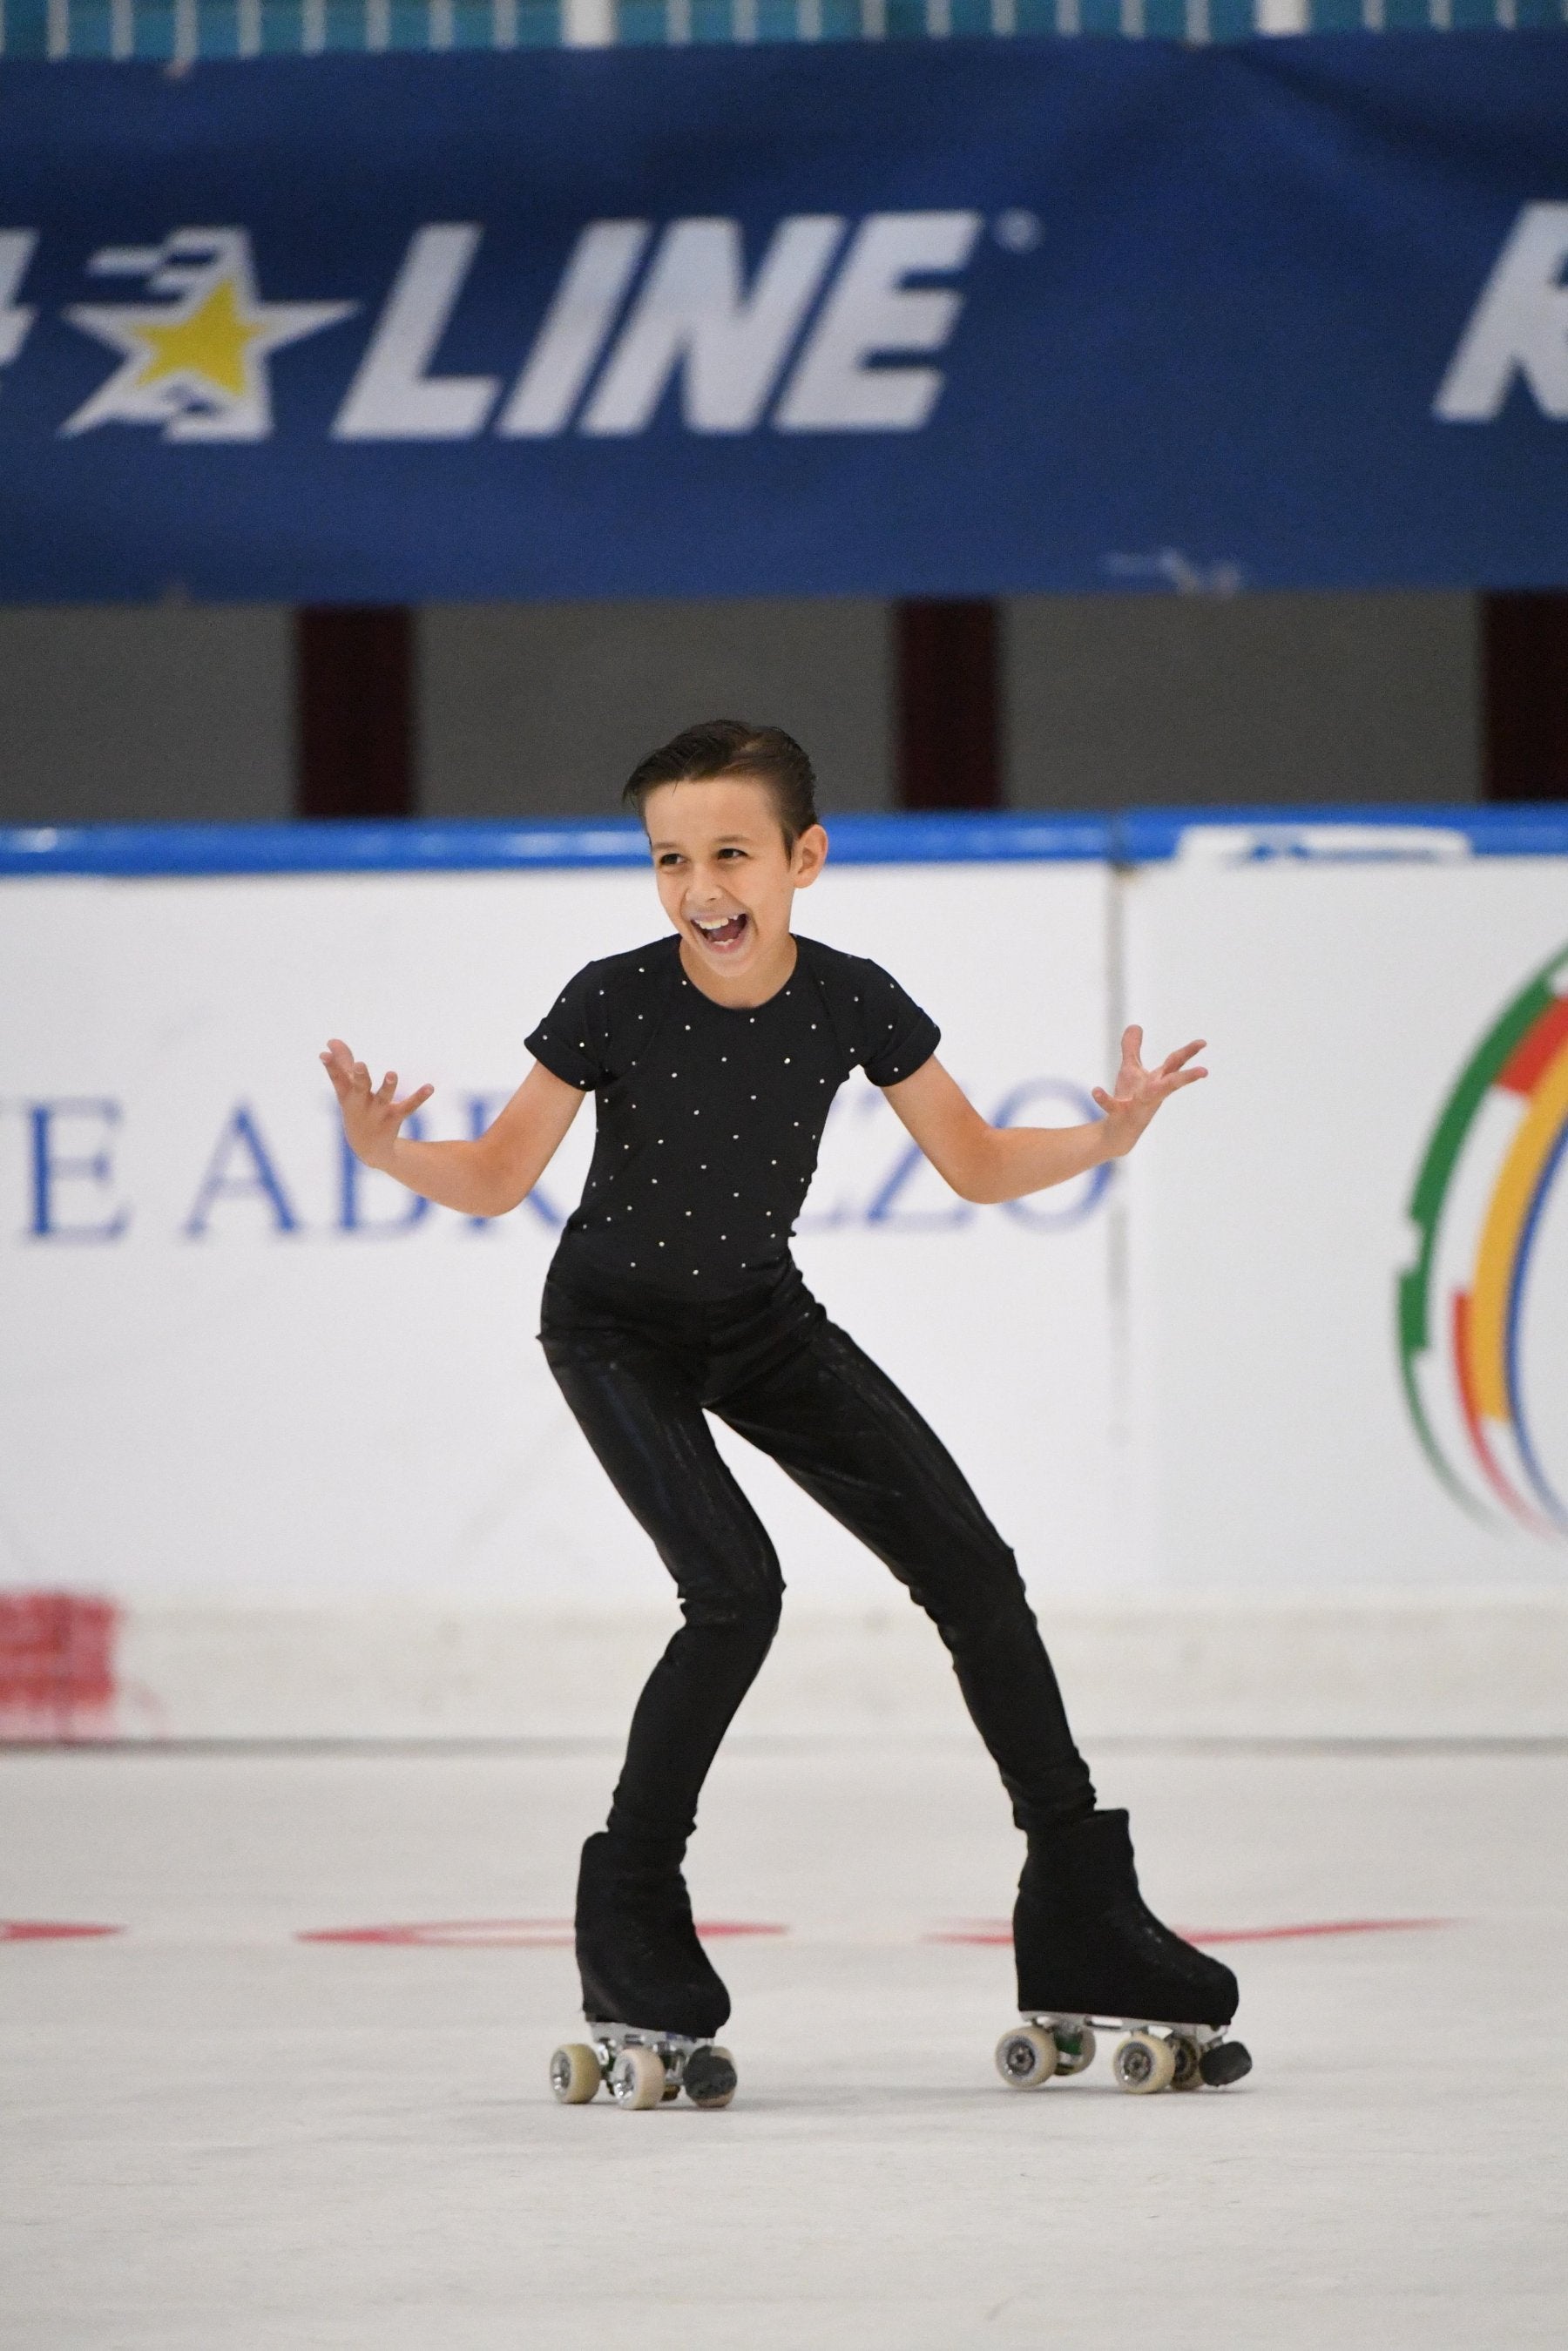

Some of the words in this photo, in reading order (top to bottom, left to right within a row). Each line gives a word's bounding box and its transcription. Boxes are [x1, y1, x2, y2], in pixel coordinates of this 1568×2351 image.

[331, 212, 982, 439] LINE
[0, 1096, 131, 1246] E
[179, 1080, 1114, 1244] ABZO
